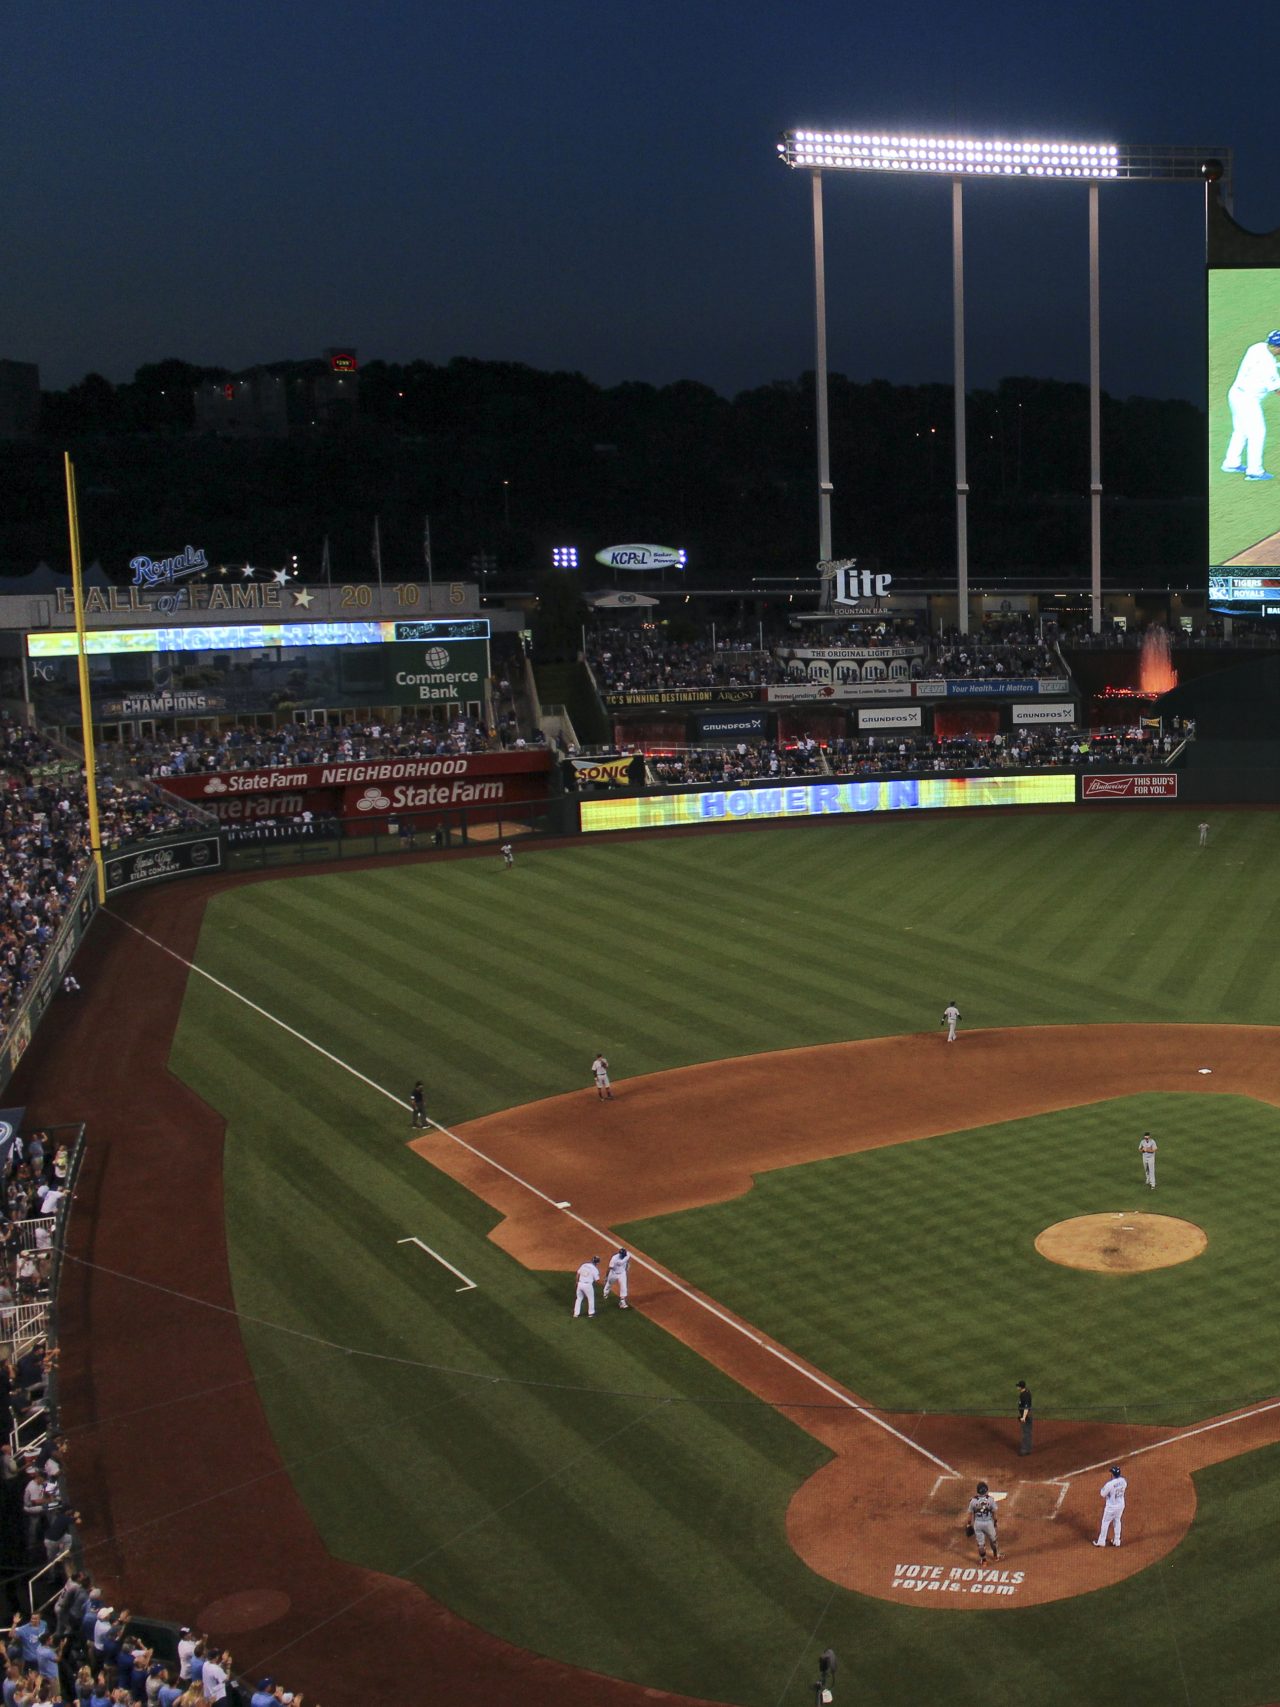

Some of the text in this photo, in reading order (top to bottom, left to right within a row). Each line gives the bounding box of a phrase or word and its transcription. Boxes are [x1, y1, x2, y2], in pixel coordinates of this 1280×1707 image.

[129, 545, 208, 588] Royals
[611, 552, 648, 565] KCP&L
[341, 584, 372, 608] 20
[393, 583, 420, 605] 10
[451, 582, 465, 604] 5
[834, 569, 892, 606] Lite
[56, 582, 282, 616] HALL of FAME
[158, 625, 265, 651] HOME
[396, 671, 478, 685] Commerce
[419, 685, 458, 699] Bank
[952, 685, 967, 693] Your
[1006, 684, 1034, 692] Matters
[122, 697, 206, 713] CHAMPIONS
[626, 693, 660, 704] WINNING
[661, 692, 712, 702] DESTINATION!
[703, 722, 751, 730] GRUNDFOS
[321, 760, 468, 784] NEIGHBORHOOD
[578, 765, 629, 779] SONIC
[1152, 777, 1174, 785] BUD'S
[1134, 786, 1167, 794] FOR YOU.
[700, 780, 920, 818] HOME RUN
[894, 1564, 1025, 1584] VOTE ROYALS
[892, 1578, 1016, 1595] royals.com
